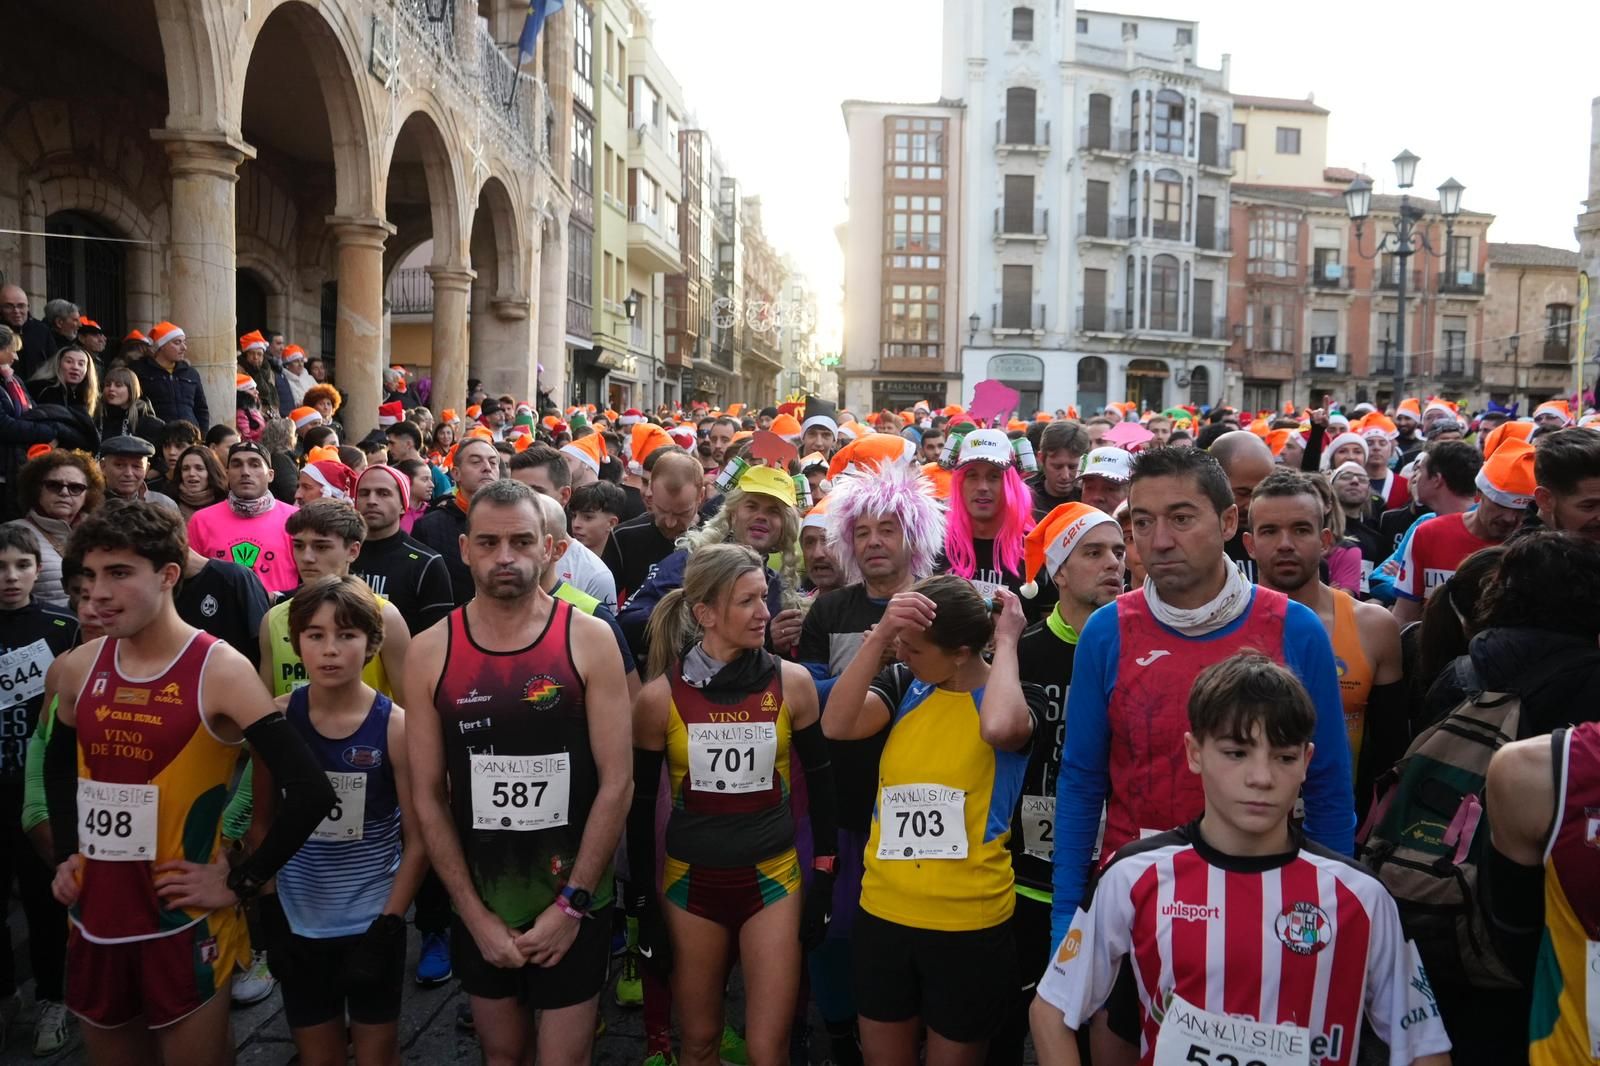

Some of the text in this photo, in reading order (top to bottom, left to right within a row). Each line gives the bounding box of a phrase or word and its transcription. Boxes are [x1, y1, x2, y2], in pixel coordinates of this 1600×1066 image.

[973, 439, 997, 447] Volcan
[0, 661, 42, 691] 644
[709, 711, 750, 722] VINO
[104, 729, 142, 744] VINO
[91, 743, 153, 762] DE TORO
[707, 747, 755, 772] 701
[492, 781, 548, 808] 587
[85, 808, 132, 838] 498
[896, 810, 944, 838] 703
[1162, 902, 1220, 920] uhlsport
